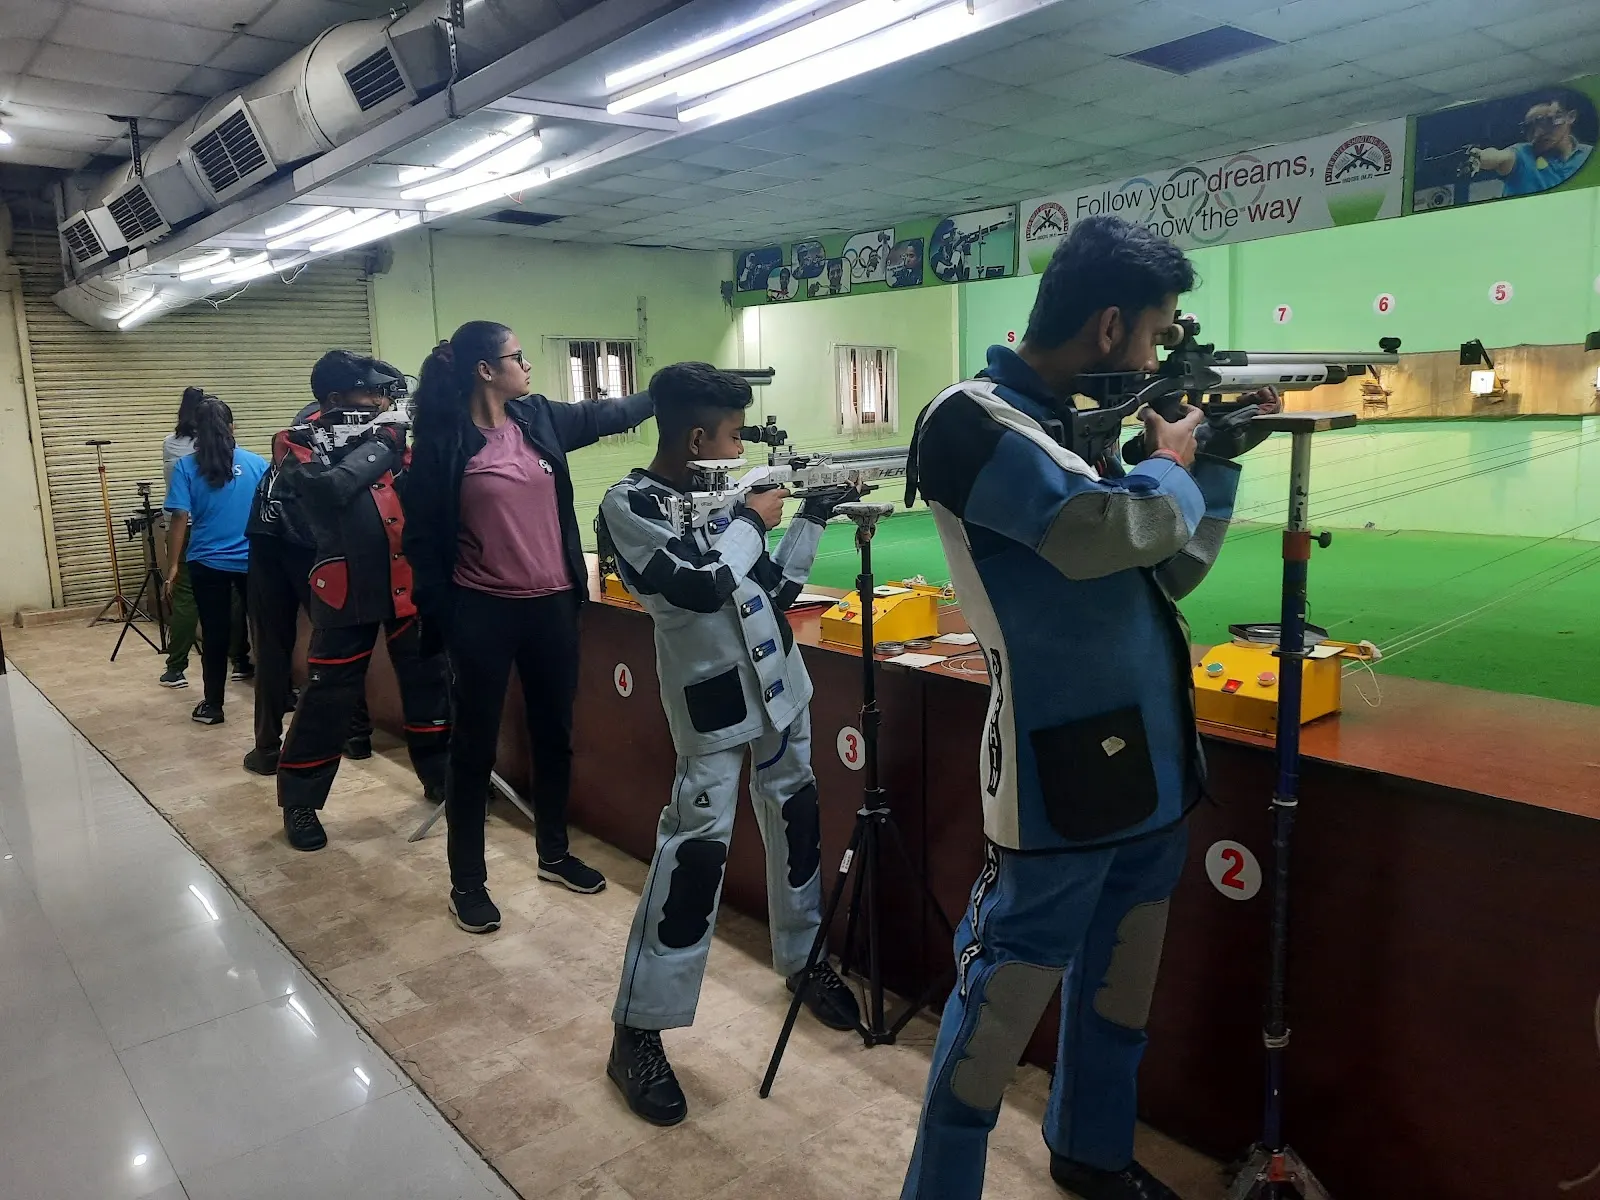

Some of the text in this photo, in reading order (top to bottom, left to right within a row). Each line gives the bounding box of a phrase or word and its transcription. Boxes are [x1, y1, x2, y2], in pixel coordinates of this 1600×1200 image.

[1076, 190, 1143, 218] Follow
[1150, 177, 1199, 210] your
[1207, 155, 1314, 192] dreams,
[1147, 196, 1302, 238] now the way
[1379, 297, 1389, 312] 6
[1495, 285, 1506, 301] 5
[1278, 308, 1287, 321] 7
[618, 669, 628, 692] 4
[845, 734, 858, 763] 3
[1221, 848, 1245, 891] 2
